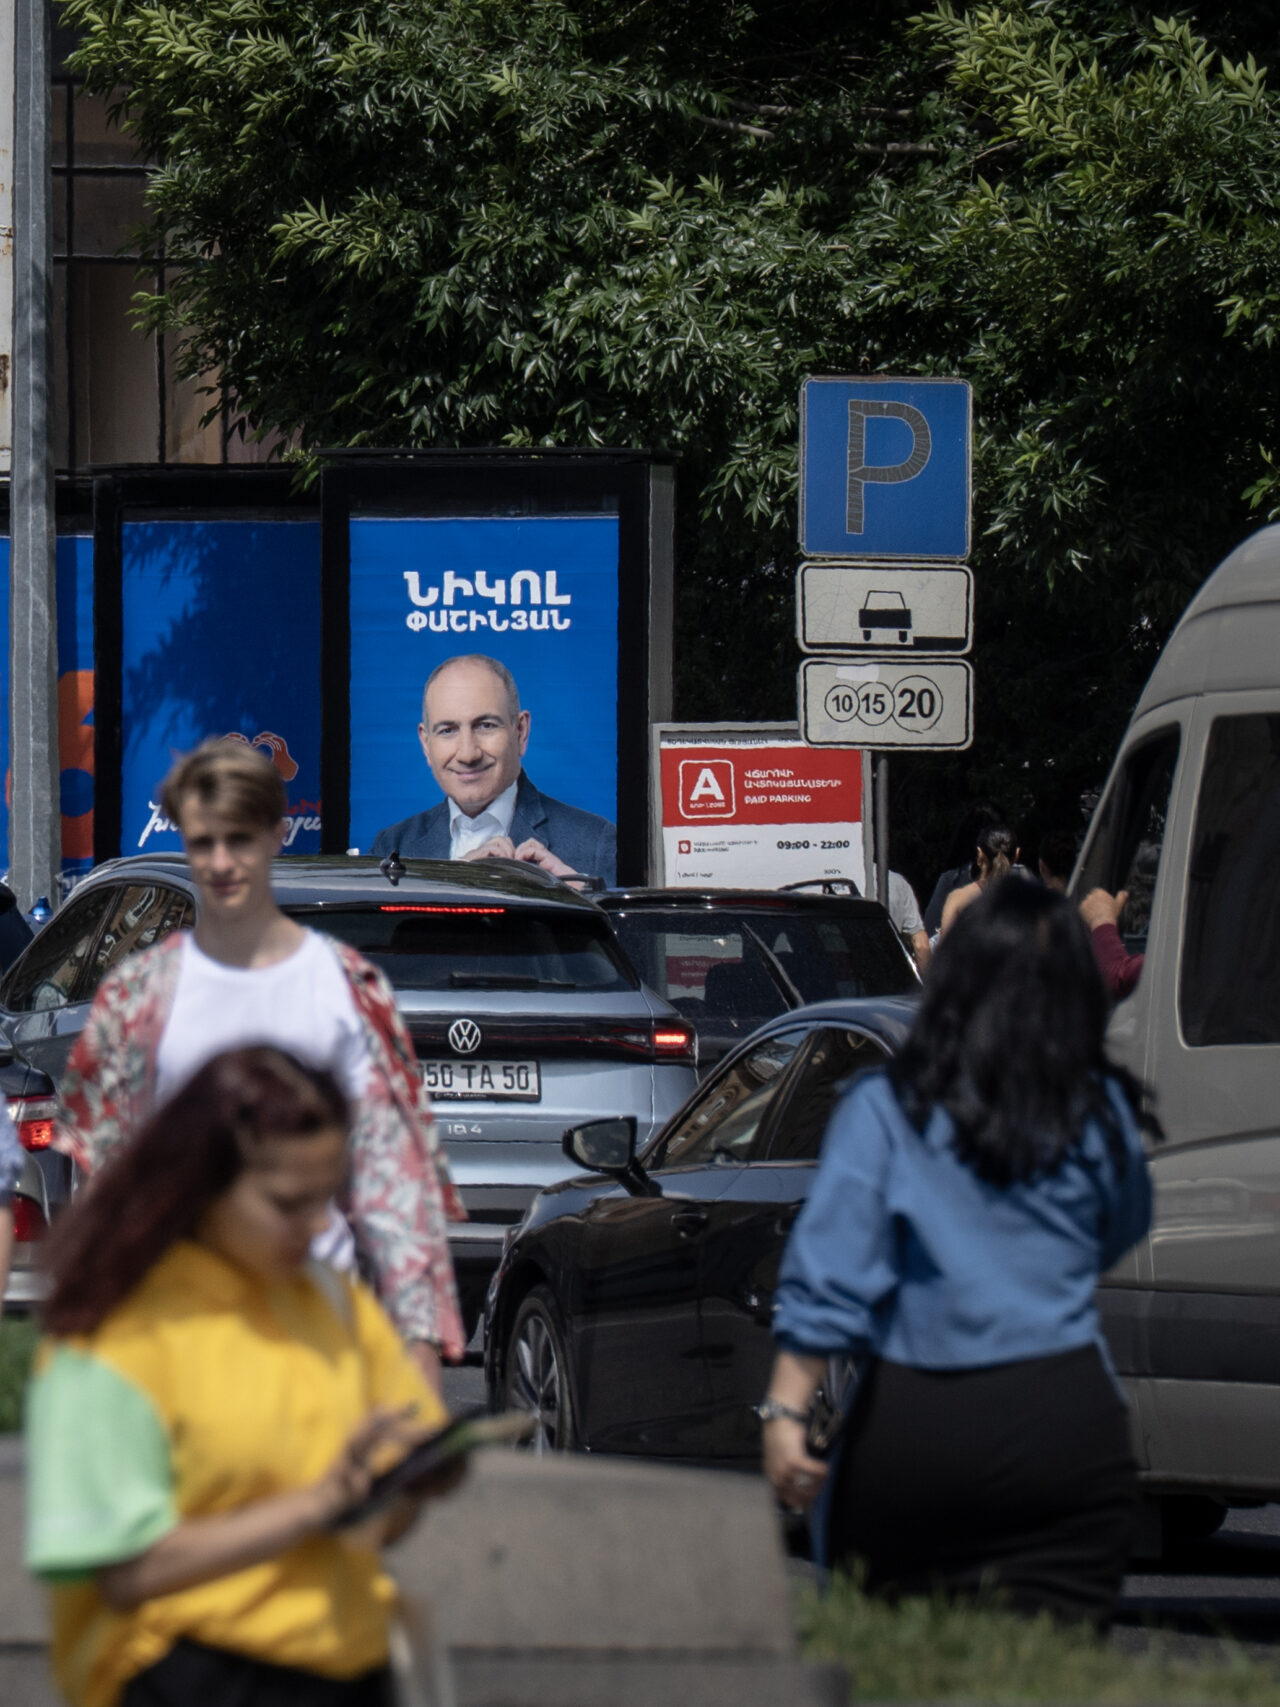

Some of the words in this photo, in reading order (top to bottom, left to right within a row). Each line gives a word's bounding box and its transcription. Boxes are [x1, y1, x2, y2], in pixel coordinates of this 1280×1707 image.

[846, 399, 932, 535] P
[403, 570, 571, 607] ՆԻԿՈԼ
[406, 610, 571, 632] ՓԱՇԻՆՅԱՆ
[831, 694, 853, 713] 10
[861, 694, 886, 715] 15
[898, 688, 935, 718] 20
[690, 768, 725, 800] A
[744, 795, 767, 804] PAID
[769, 795, 812, 803] PARKING
[776, 840, 810, 850] 09:00
[820, 840, 850, 849] 22:00
[419, 1063, 453, 1088] 50
[461, 1064, 495, 1089] TA
[502, 1065, 530, 1090] 50
